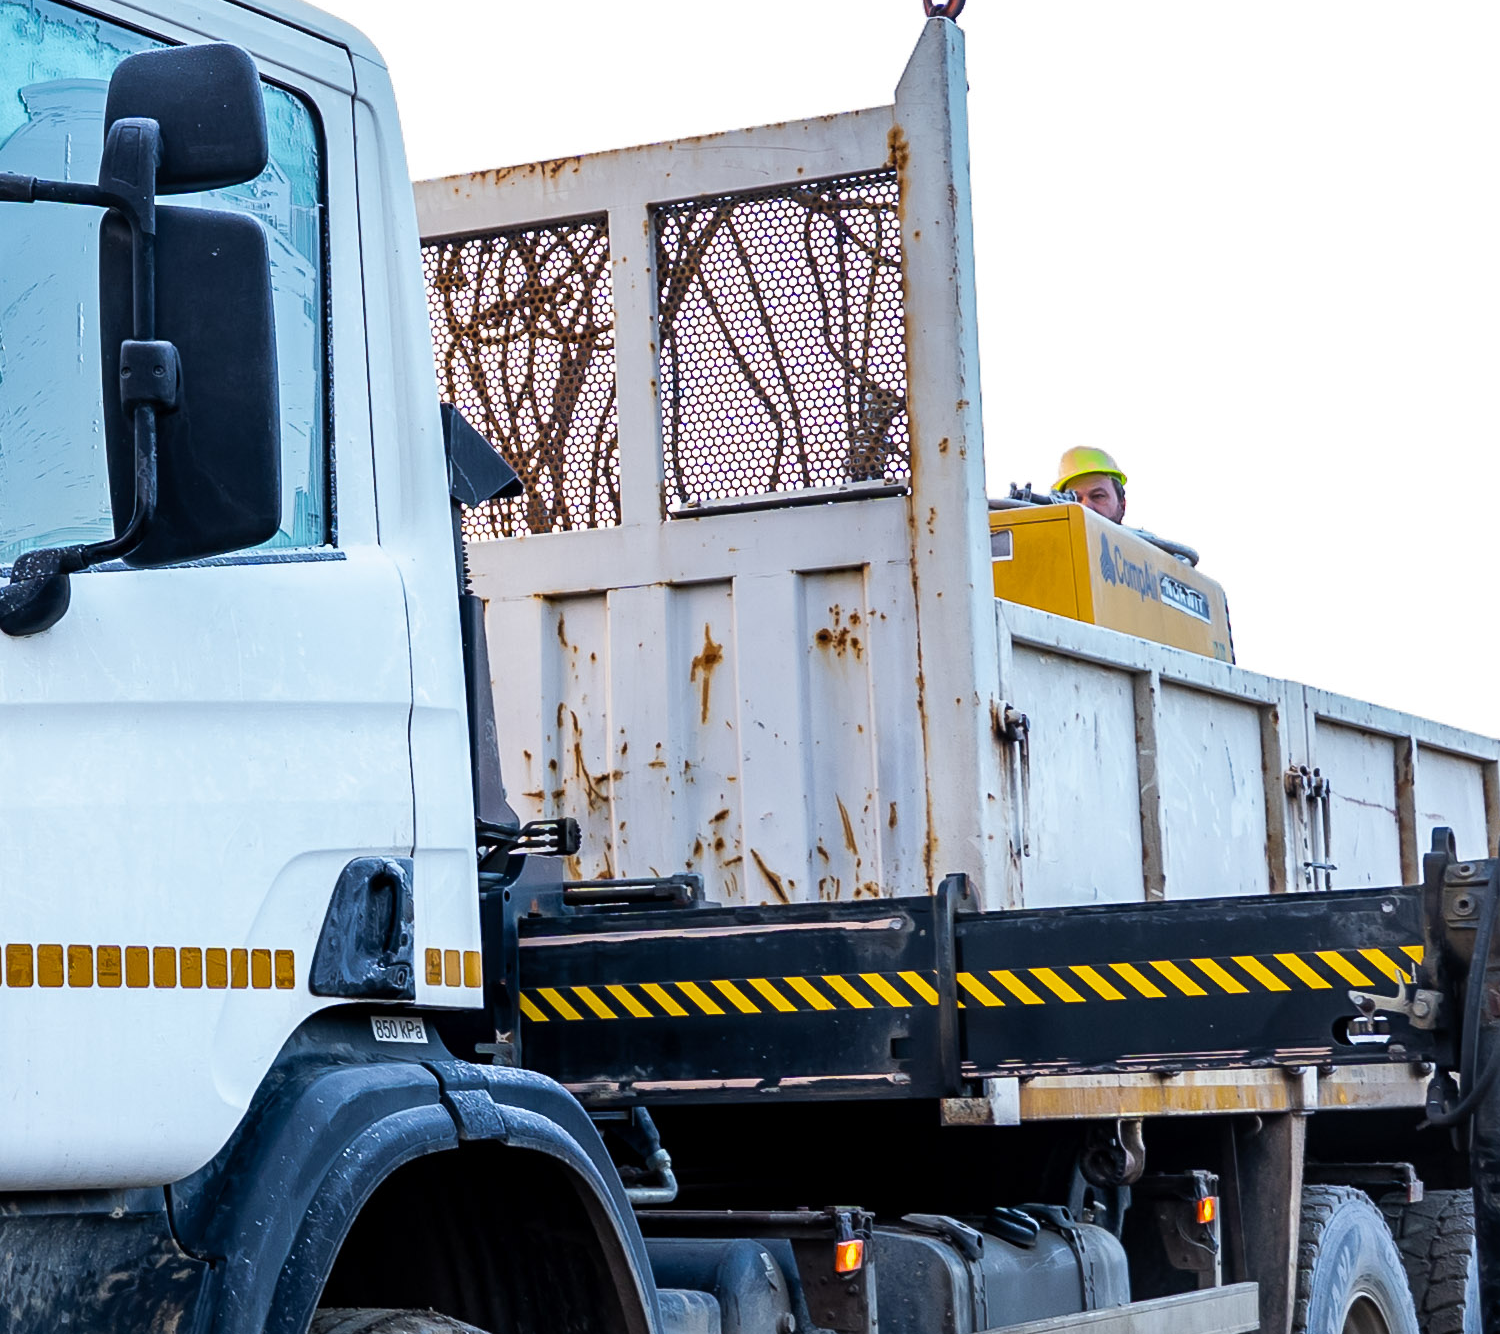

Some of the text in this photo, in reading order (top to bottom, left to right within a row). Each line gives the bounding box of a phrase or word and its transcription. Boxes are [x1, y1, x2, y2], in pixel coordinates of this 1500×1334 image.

[1113, 544, 1160, 603] CompAir
[375, 1019, 424, 1040] 850 kPa
